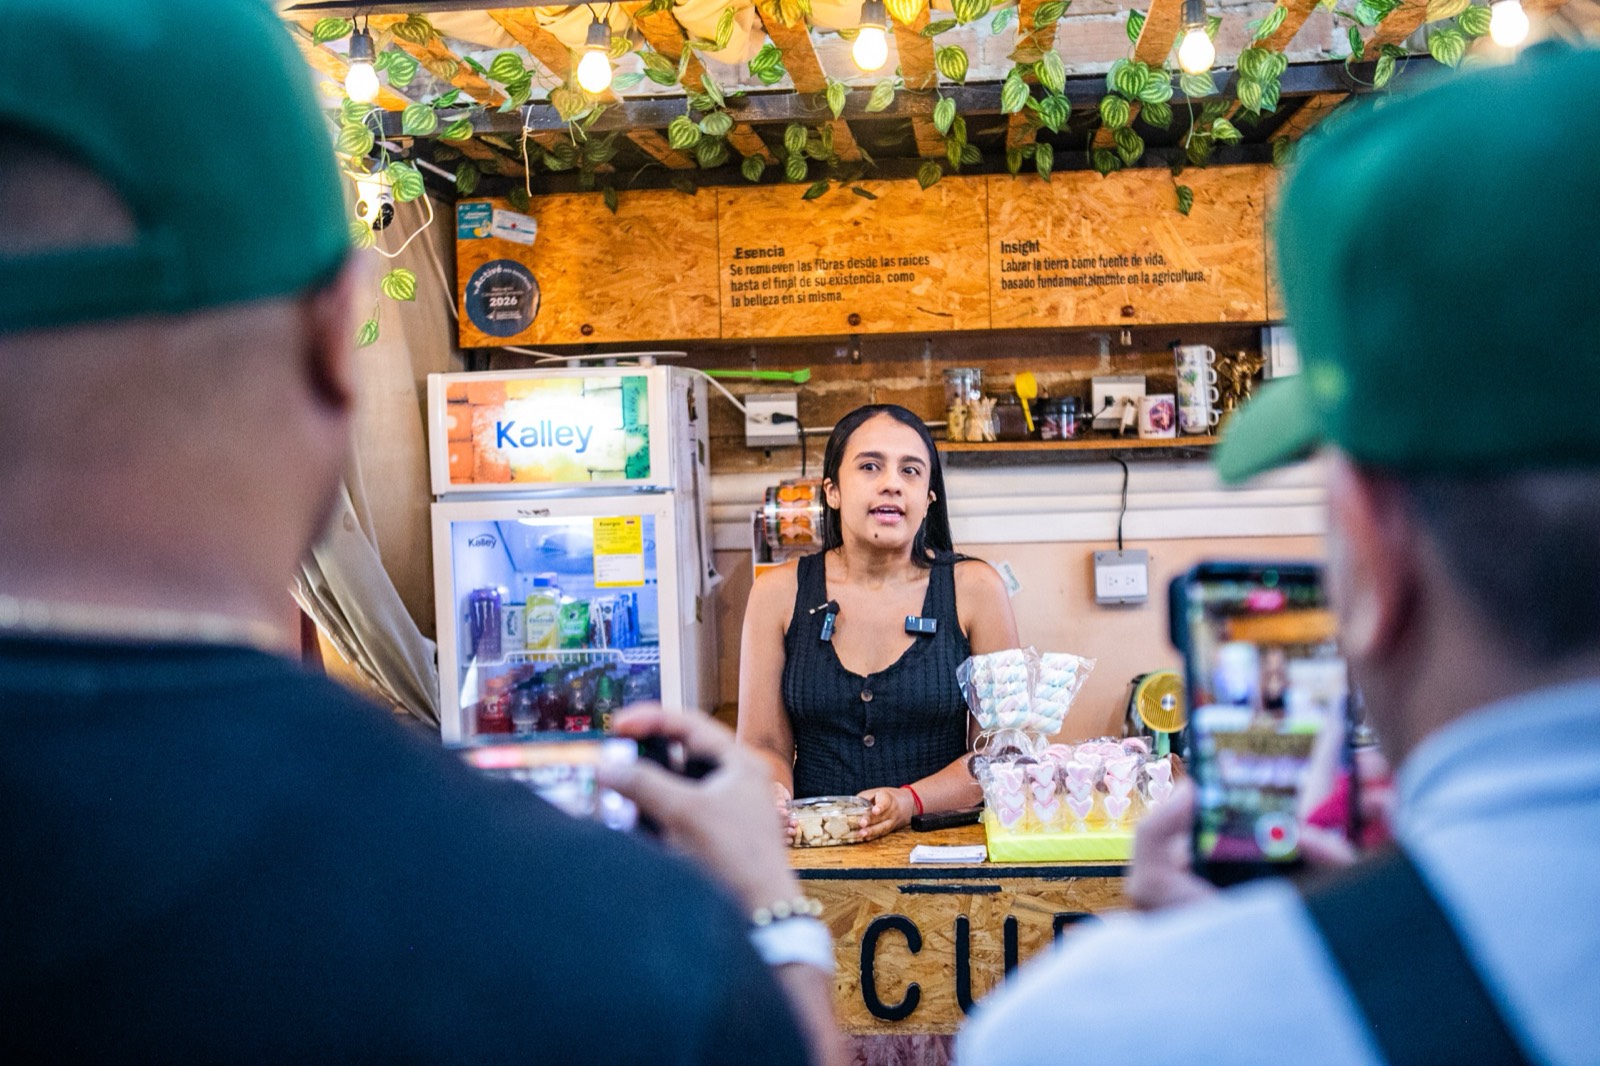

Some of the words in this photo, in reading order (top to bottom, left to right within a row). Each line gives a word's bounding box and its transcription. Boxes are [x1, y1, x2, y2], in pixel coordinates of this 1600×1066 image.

[733, 245, 785, 259] Esencia
[1001, 240, 1040, 256] Insight
[730, 264, 743, 276] Se
[745, 262, 794, 275] remueven
[797, 260, 812, 272] las
[814, 258, 844, 270] fibras
[847, 256, 878, 269] desde
[880, 255, 896, 267] las
[898, 253, 930, 267] raíces
[1001, 258, 1031, 272] Labrar
[1033, 257, 1042, 271] la
[1043, 256, 1069, 270] tierra
[1071, 258, 1096, 269] como
[1099, 254, 1129, 268] fuente
[1131, 253, 1142, 266] de
[731, 279, 760, 292] hasta
[762, 278, 771, 290] el
[773, 276, 797, 289] final
[799, 276, 812, 287] de
[814, 277, 827, 287] su
[828, 272, 885, 286] existencia,
[887, 272, 915, 283] como
[1001, 275, 1035, 290] basado
[1037, 272, 1126, 288] fundamentalmente
[1127, 273, 1139, 285] en
[1141, 271, 1150, 284] la
[489, 296, 518, 307] 2026
[731, 295, 741, 308] la
[743, 294, 780, 306] belleza
[781, 294, 795, 304] en
[808, 290, 846, 303] misma.
[496, 419, 594, 453] Kalley
[468, 537, 497, 549] Kalley
